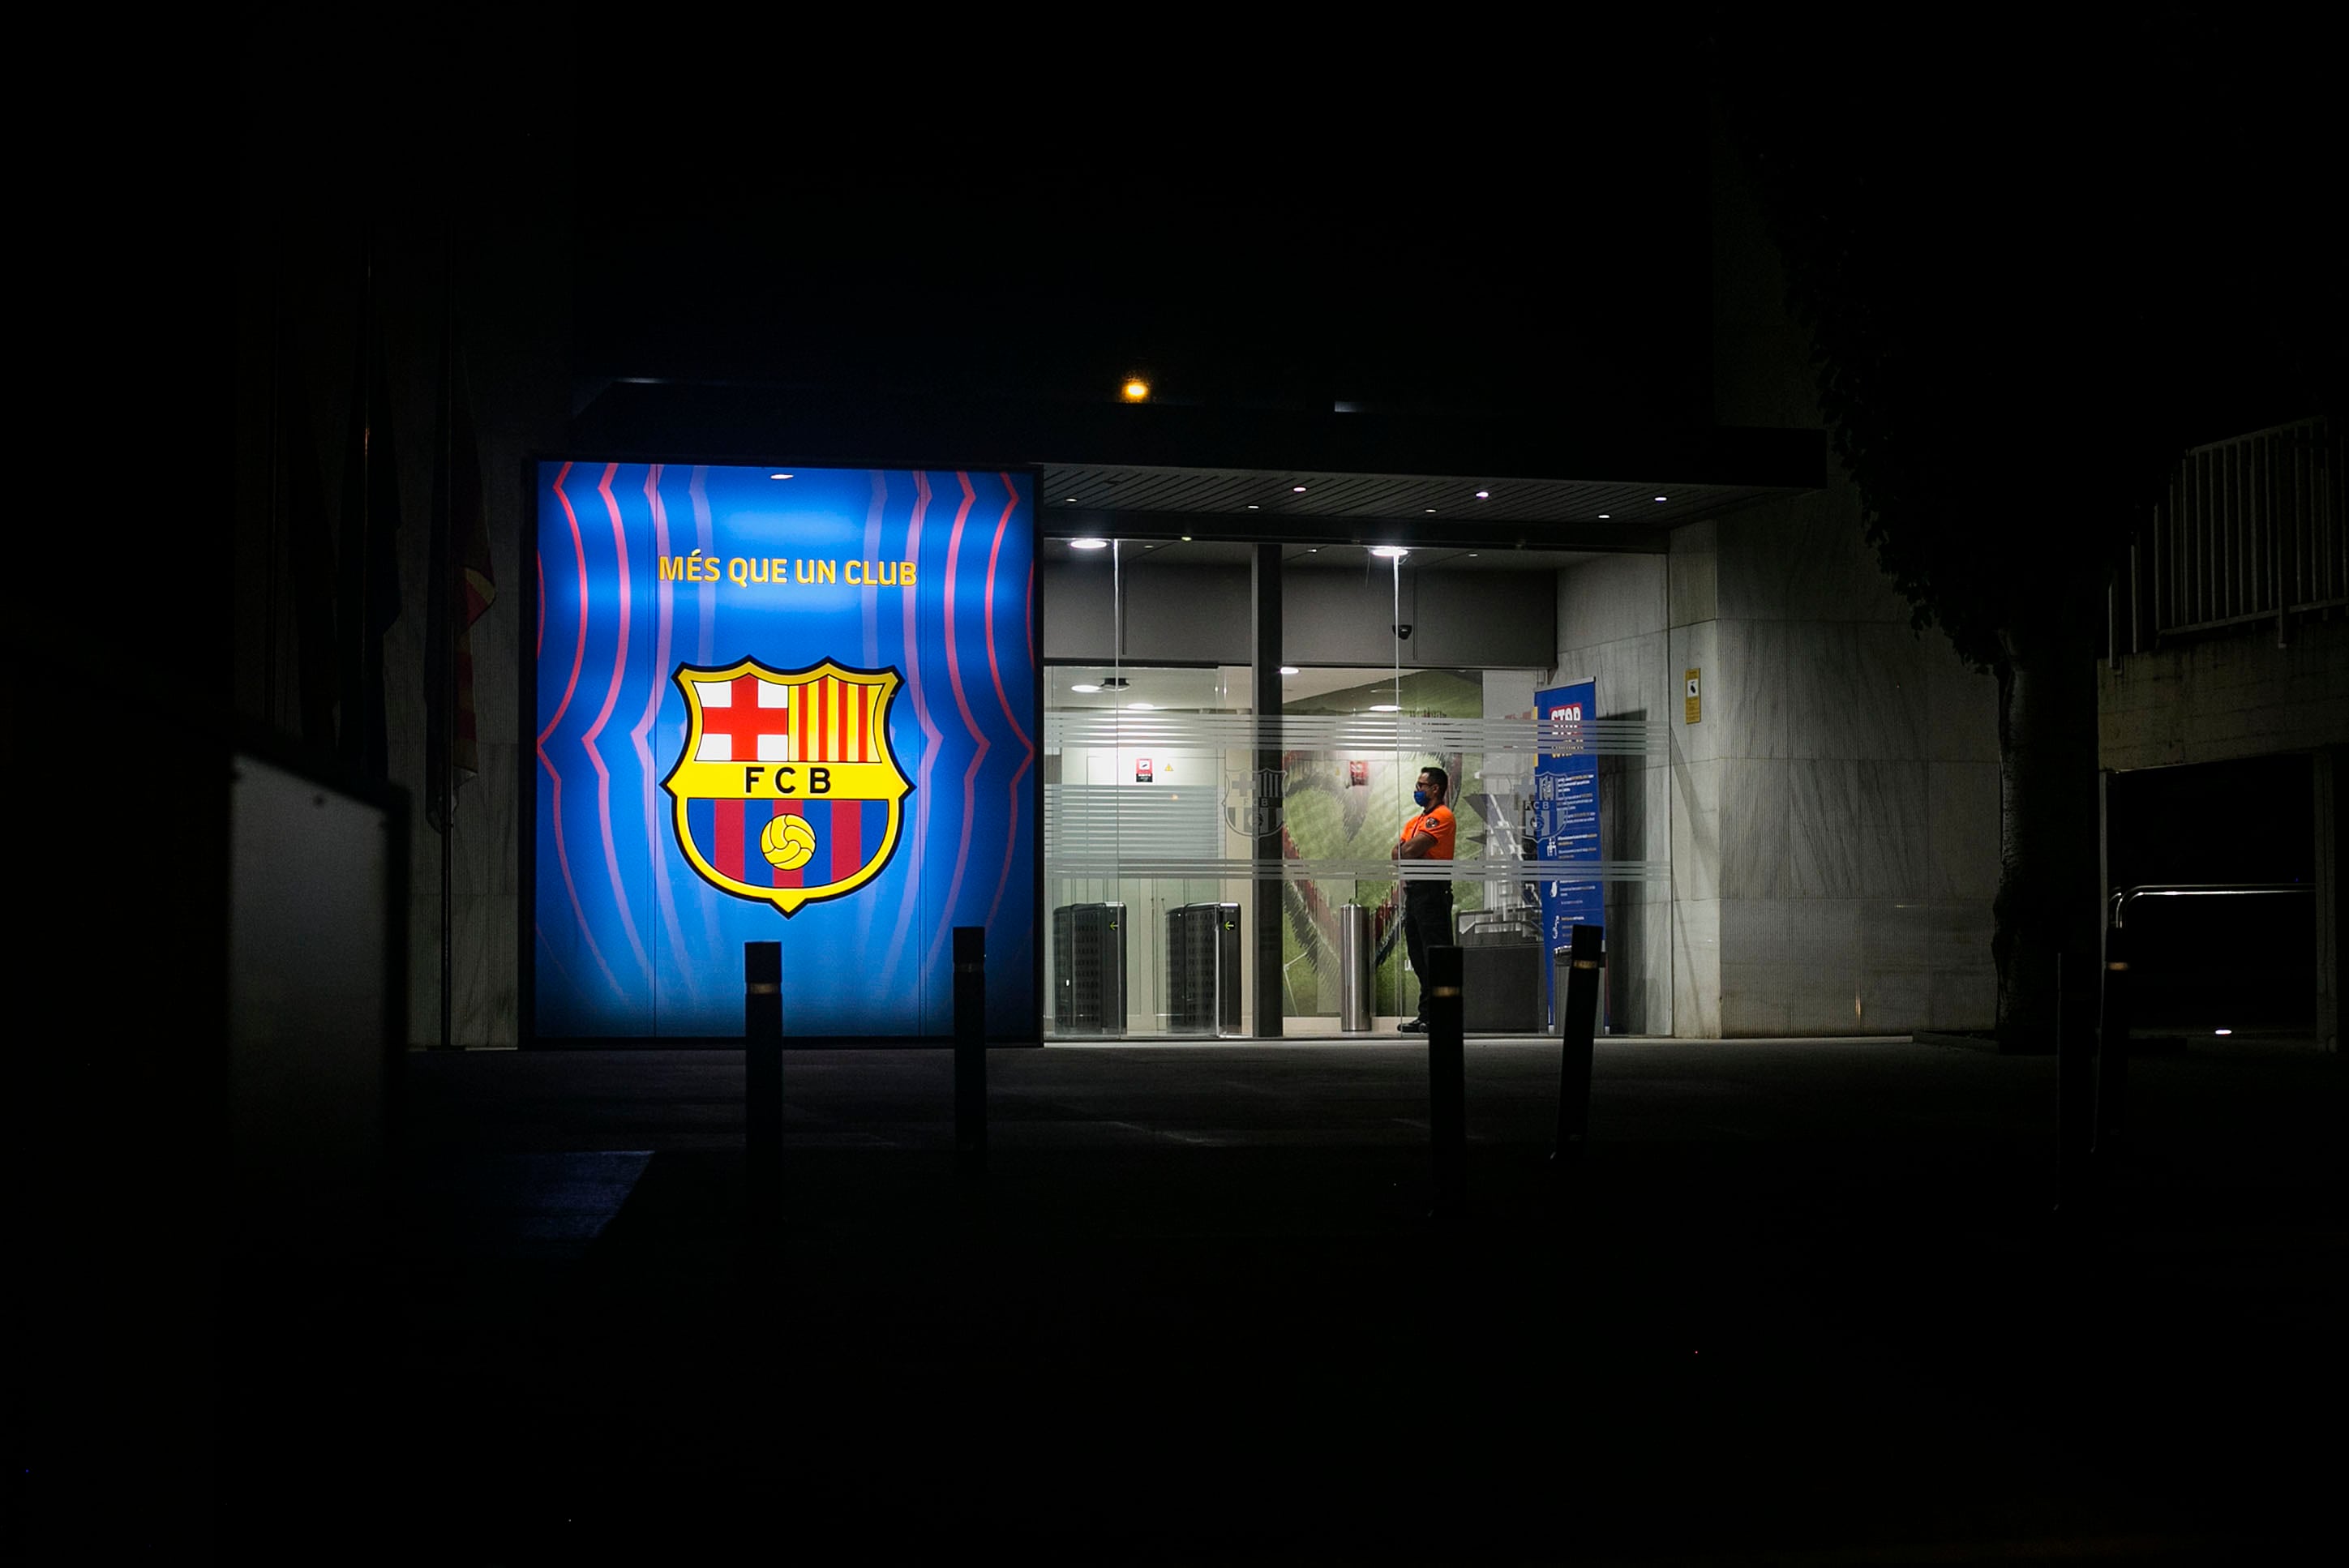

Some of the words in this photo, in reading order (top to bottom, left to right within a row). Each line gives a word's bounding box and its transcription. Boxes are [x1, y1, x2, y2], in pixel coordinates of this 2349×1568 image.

[658, 549, 720, 582] MÉS
[728, 557, 787, 588] QUE
[795, 559, 836, 584] UN
[844, 560, 918, 586] CLUB
[745, 766, 831, 794] FCB
